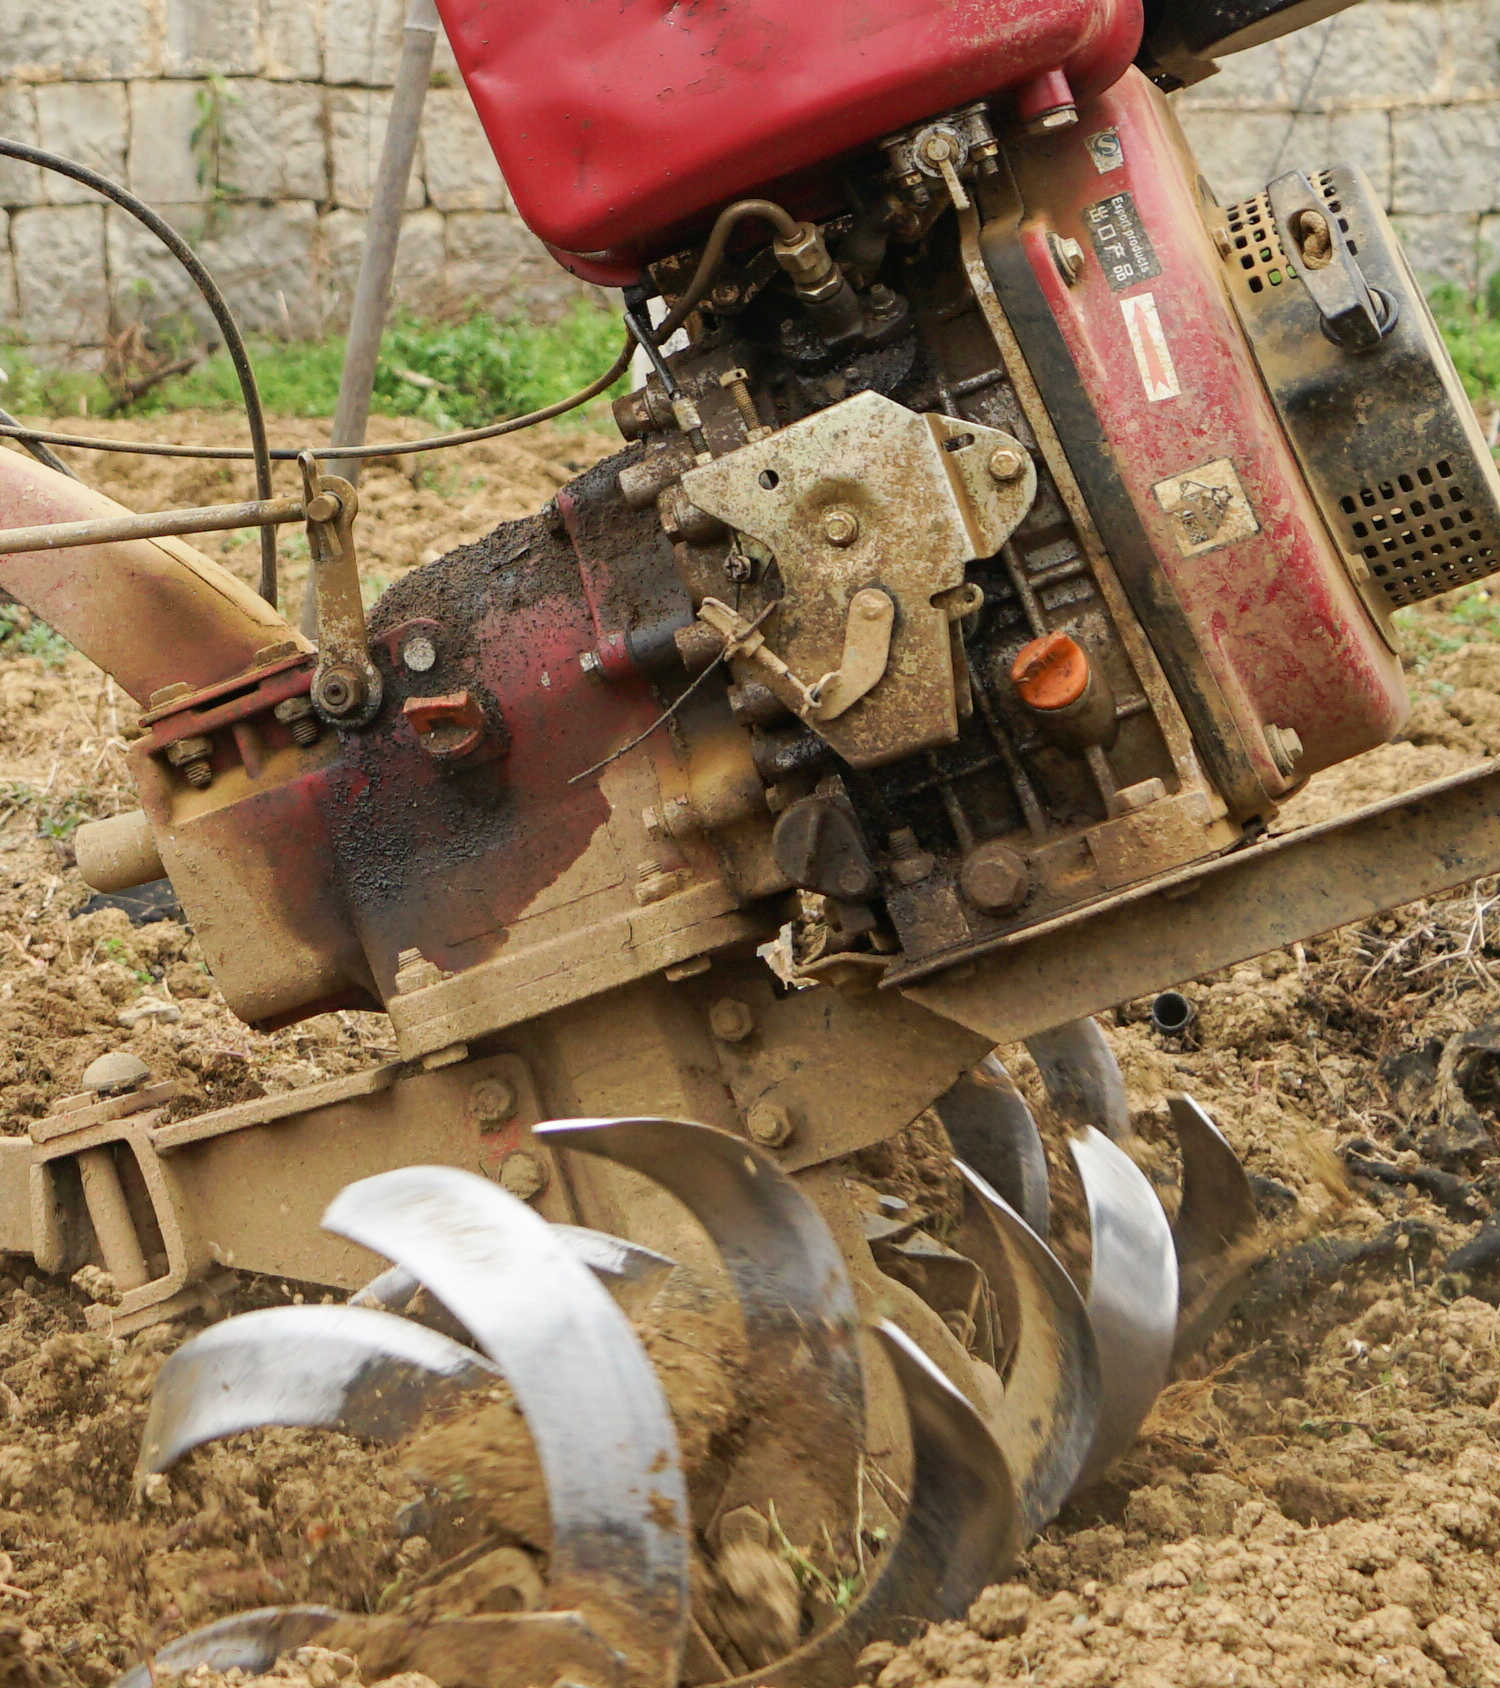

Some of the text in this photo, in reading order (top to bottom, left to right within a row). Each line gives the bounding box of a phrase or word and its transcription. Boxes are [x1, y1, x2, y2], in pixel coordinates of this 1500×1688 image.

[1089, 205, 1134, 281] 出口产品
[1111, 196, 1149, 273] Export products
